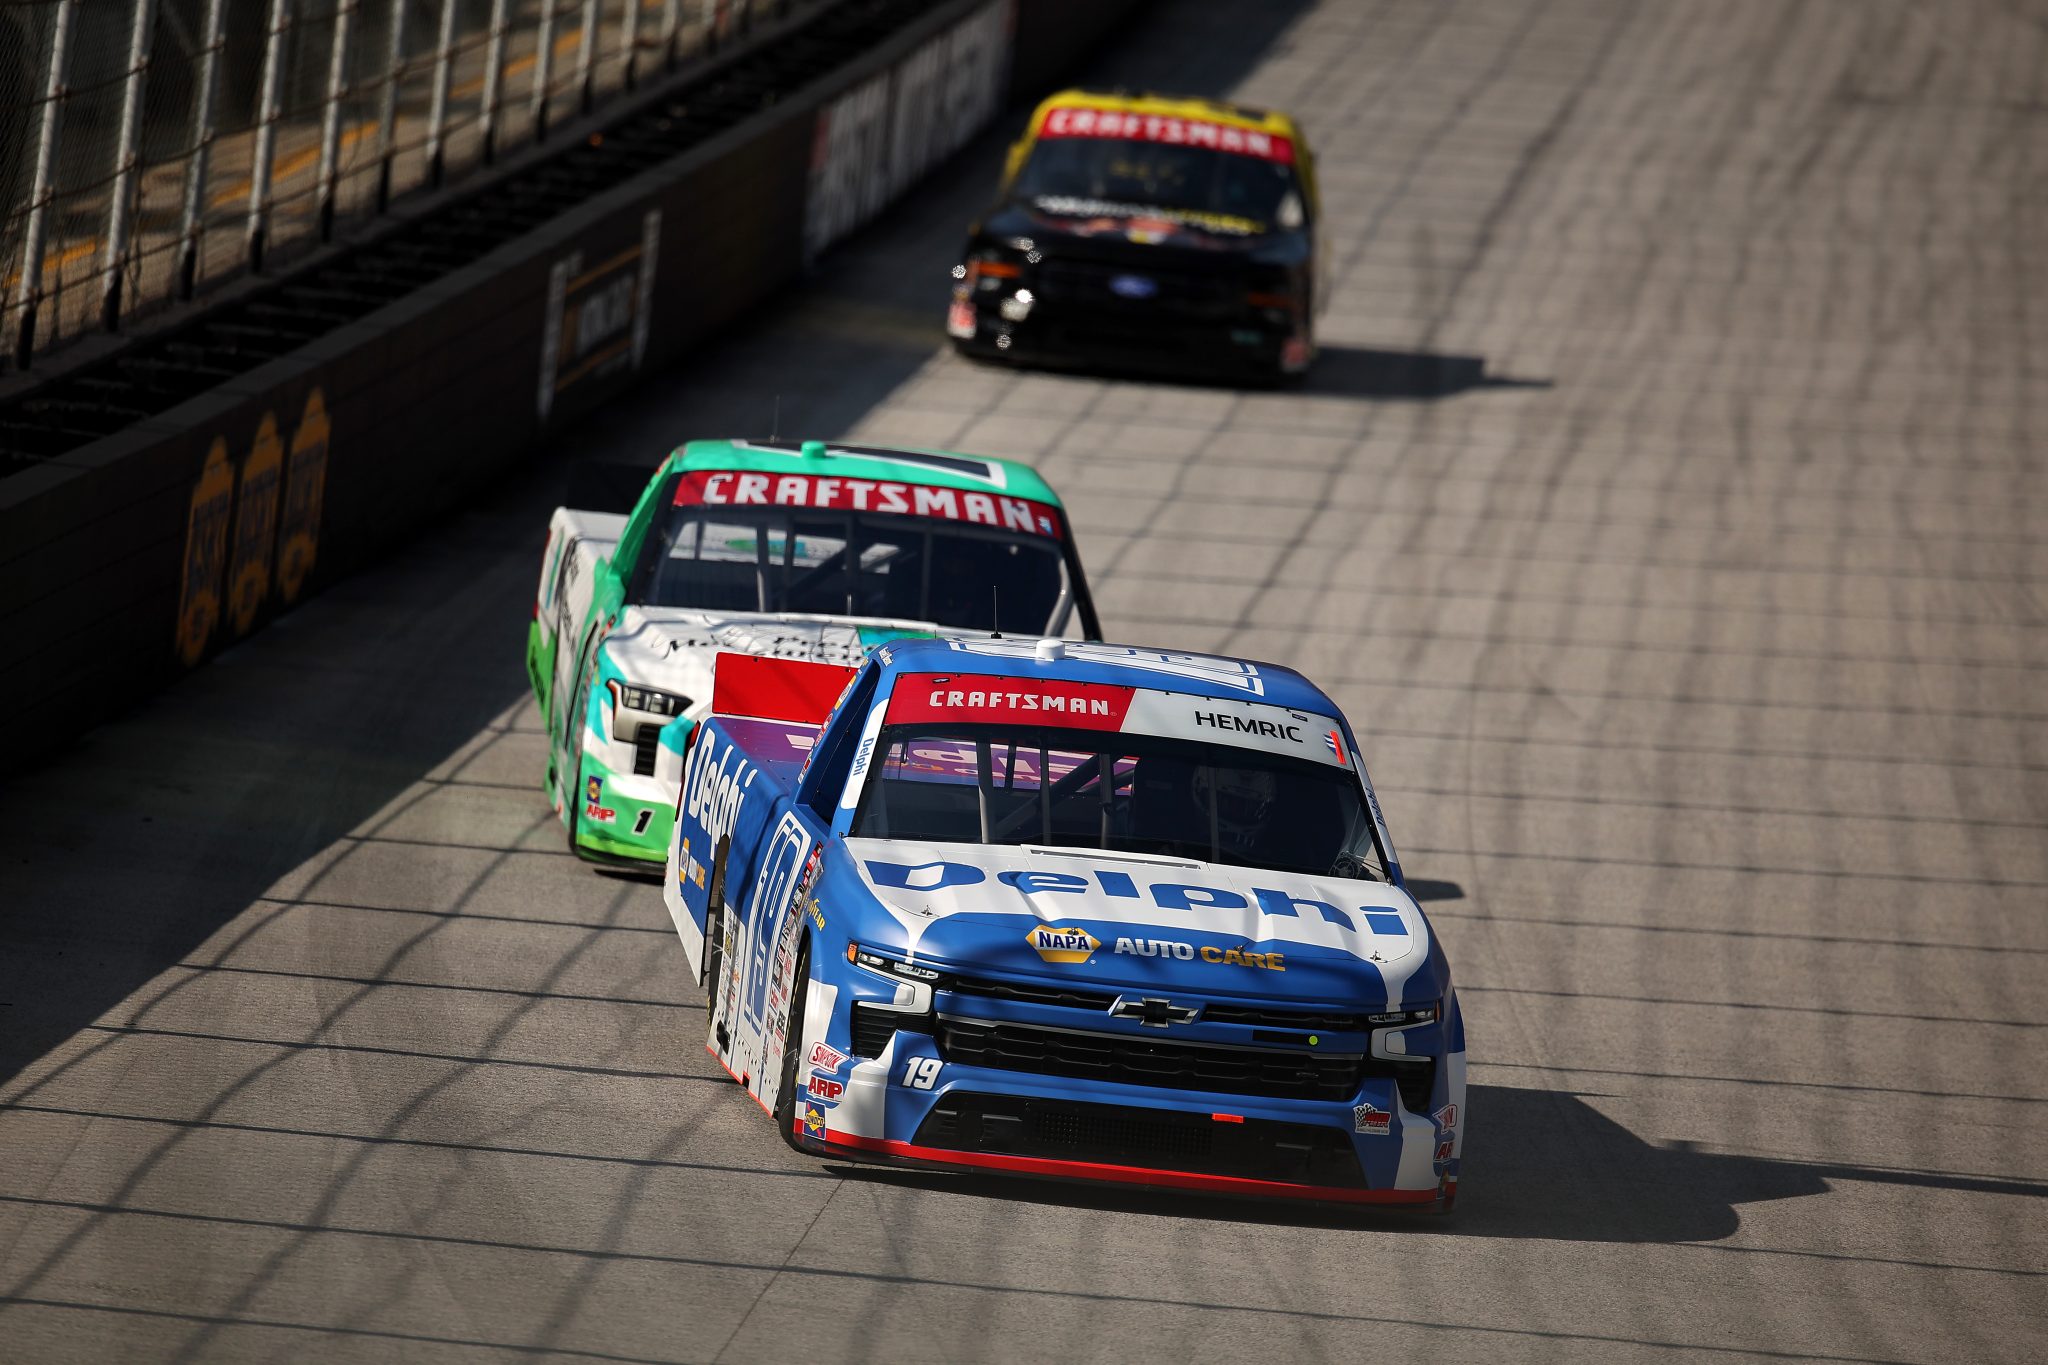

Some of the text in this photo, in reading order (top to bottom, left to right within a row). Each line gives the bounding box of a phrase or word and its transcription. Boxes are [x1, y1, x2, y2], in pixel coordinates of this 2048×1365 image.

[1049, 107, 1272, 157] CRAFTSMAN
[702, 473, 1036, 533] CRAFTSMAN
[929, 690, 1110, 716] CRAFTSMAN
[1194, 710, 1304, 744] HEMRIC
[853, 737, 875, 776] Delphi
[688, 727, 758, 862] Delphi
[635, 809, 654, 836] 1
[863, 859, 1409, 936] Delphi
[1038, 931, 1287, 972] NAPA AUTO CARE
[812, 1045, 843, 1070] SIMPSON
[902, 1056, 943, 1090] 19
[808, 1079, 843, 1099] ARP
[804, 1113, 825, 1128] SUNOCO
